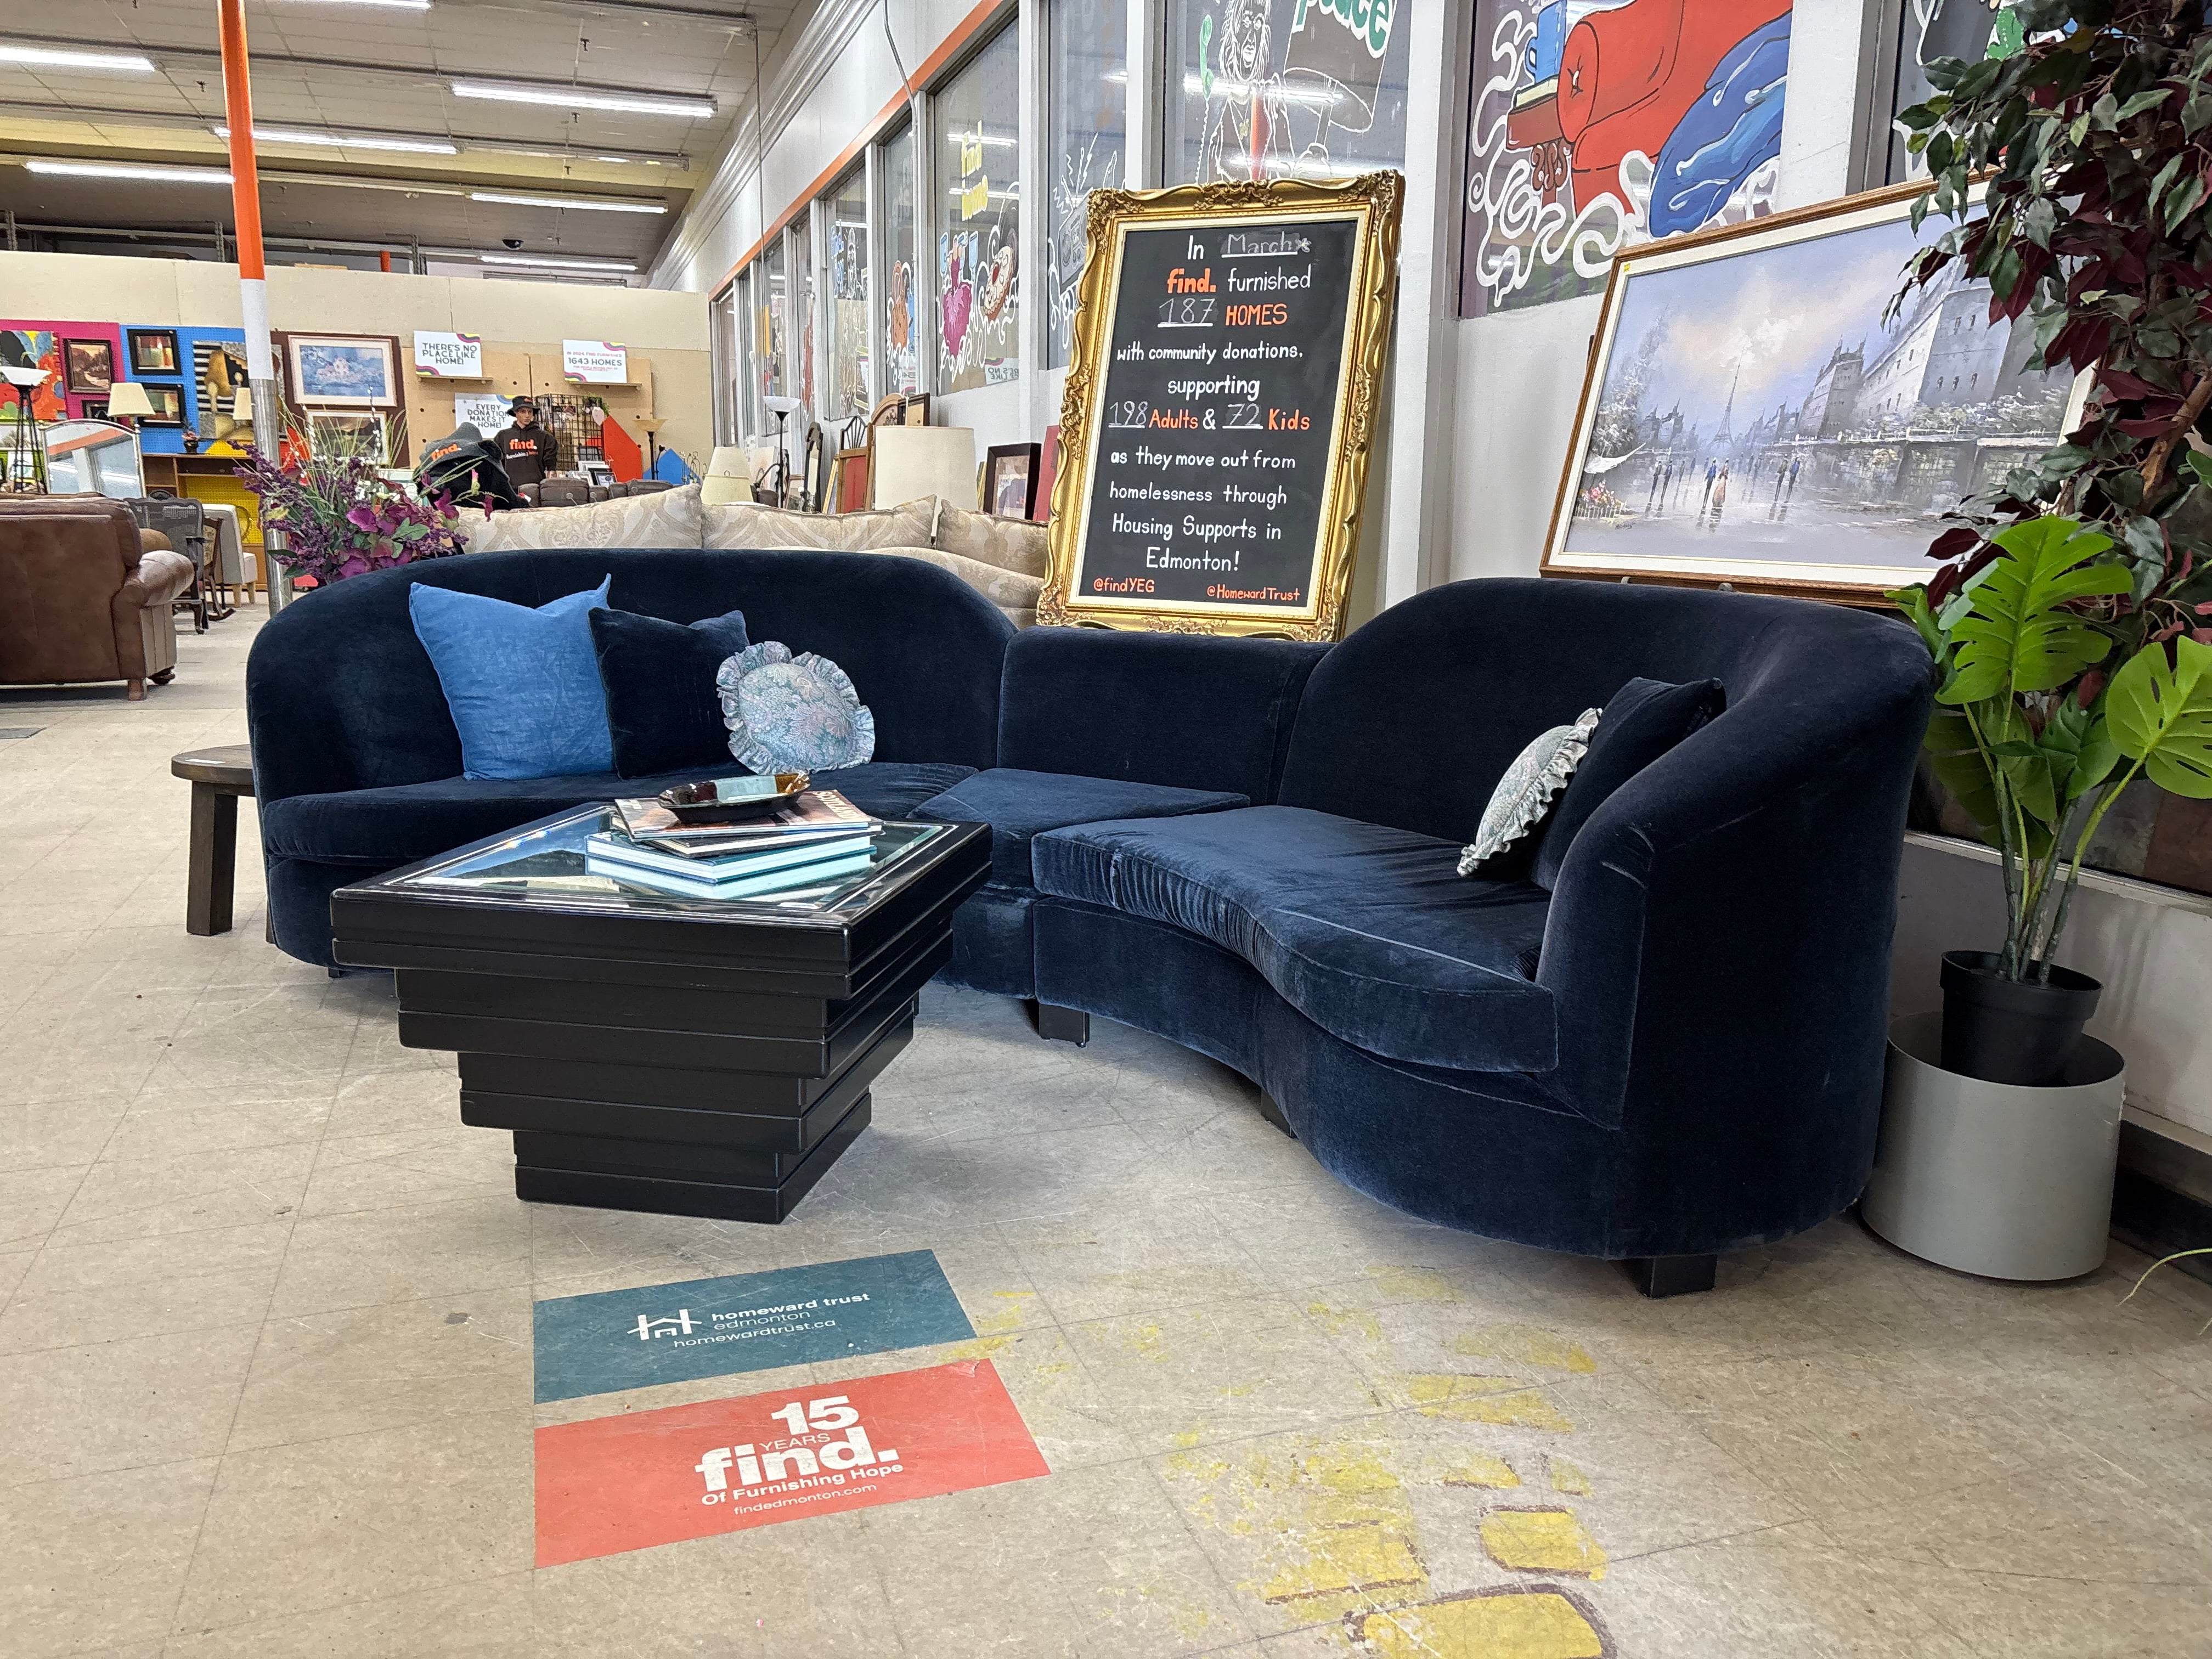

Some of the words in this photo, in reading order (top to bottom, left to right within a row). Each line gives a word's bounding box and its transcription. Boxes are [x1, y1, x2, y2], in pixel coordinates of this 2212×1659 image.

[1187, 235, 1204, 260] In
[1227, 230, 1293, 254] March
[1167, 268, 1217, 294] find.
[1228, 263, 1312, 292] furnished
[1158, 298, 1216, 324] 187
[1225, 303, 1288, 326] HOMES
[422, 342, 461, 351] THERE'S
[422, 349, 454, 358] PLACE
[1116, 341, 1145, 361] with
[1148, 342, 1216, 365] community
[591, 358, 623, 366] HOMES
[1167, 375, 1261, 402] supporting
[476, 403, 501, 411] EVERY
[1108, 400, 1149, 426] 198
[1148, 409, 1199, 429] Adults
[1202, 408, 1216, 430] &
[1227, 403, 1261, 427] 72
[1268, 408, 1311, 430] Kids
[430, 443, 462, 461] find.
[509, 438, 538, 450] find.
[1110, 451, 1127, 464] as
[1135, 445, 1173, 471] they
[1175, 453, 1215, 466] move
[1221, 449, 1249, 467] out
[1253, 449, 1296, 469] from
[1109, 481, 1213, 502] homelessness
[1223, 484, 1288, 510] through
[1112, 512, 1173, 541] Housing
[1183, 514, 1257, 544] Supports
[1266, 522, 1282, 540] in
[1146, 546, 1240, 572] Edmonton!
[1093, 577, 1155, 594] @findYEG
[711, 1299, 818, 1322] homeward
[822, 1292, 871, 1307] trust
[713, 1310, 811, 1331] edmonton
[673, 1319, 836, 1348] homewardtrust.ca
[771, 1395, 859, 1436] 15
[759, 1432, 832, 1452] YEARS
[694, 1425, 900, 1492] find.
[701, 1492, 726, 1506] Of
[732, 1472, 845, 1500] Furnishing
[850, 1463, 904, 1480] Hope
[733, 1483, 878, 1515] findedmonton.com
